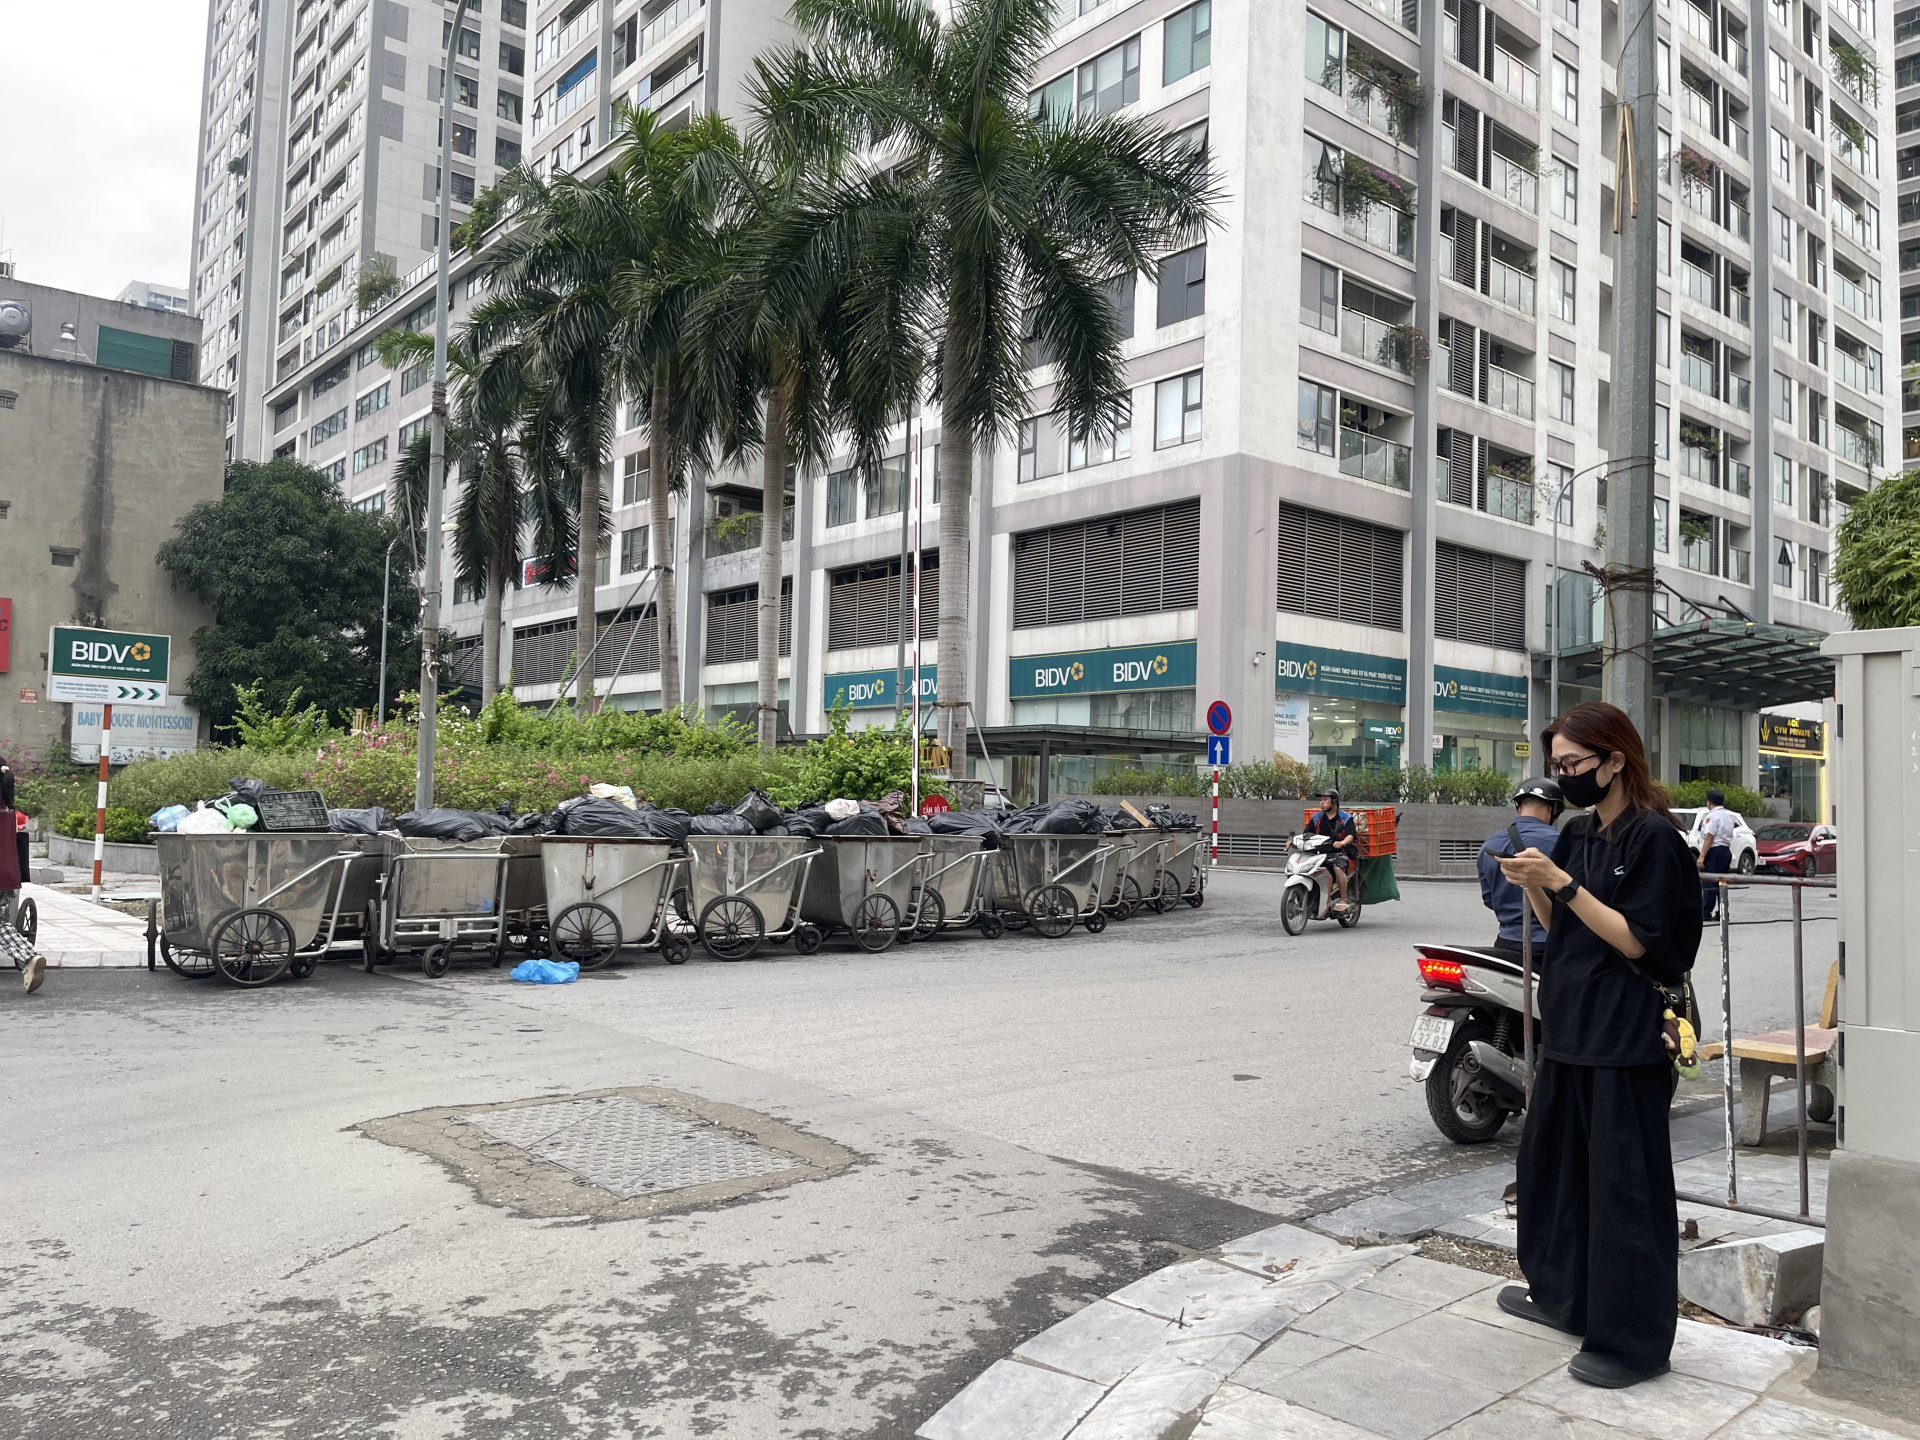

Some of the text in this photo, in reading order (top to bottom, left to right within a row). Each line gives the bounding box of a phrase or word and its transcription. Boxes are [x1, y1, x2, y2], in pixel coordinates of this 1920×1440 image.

[71, 641, 131, 663] BIDV
[1035, 666, 1071, 688] BIDV
[1113, 660, 1153, 683] BIDV
[1278, 660, 1307, 678] BIDV
[849, 683, 874, 700] BIDV
[919, 678, 938, 695] IDV
[1434, 681, 1449, 697] DV
[78, 711, 193, 730] BABY OUSE MONTESSORI
[1787, 719, 1799, 727] ACE
[1386, 726, 1398, 735] BIDV
[1774, 726, 1811, 737] GYM PRIVATE
[1411, 1031, 1446, 1051] 432.82
